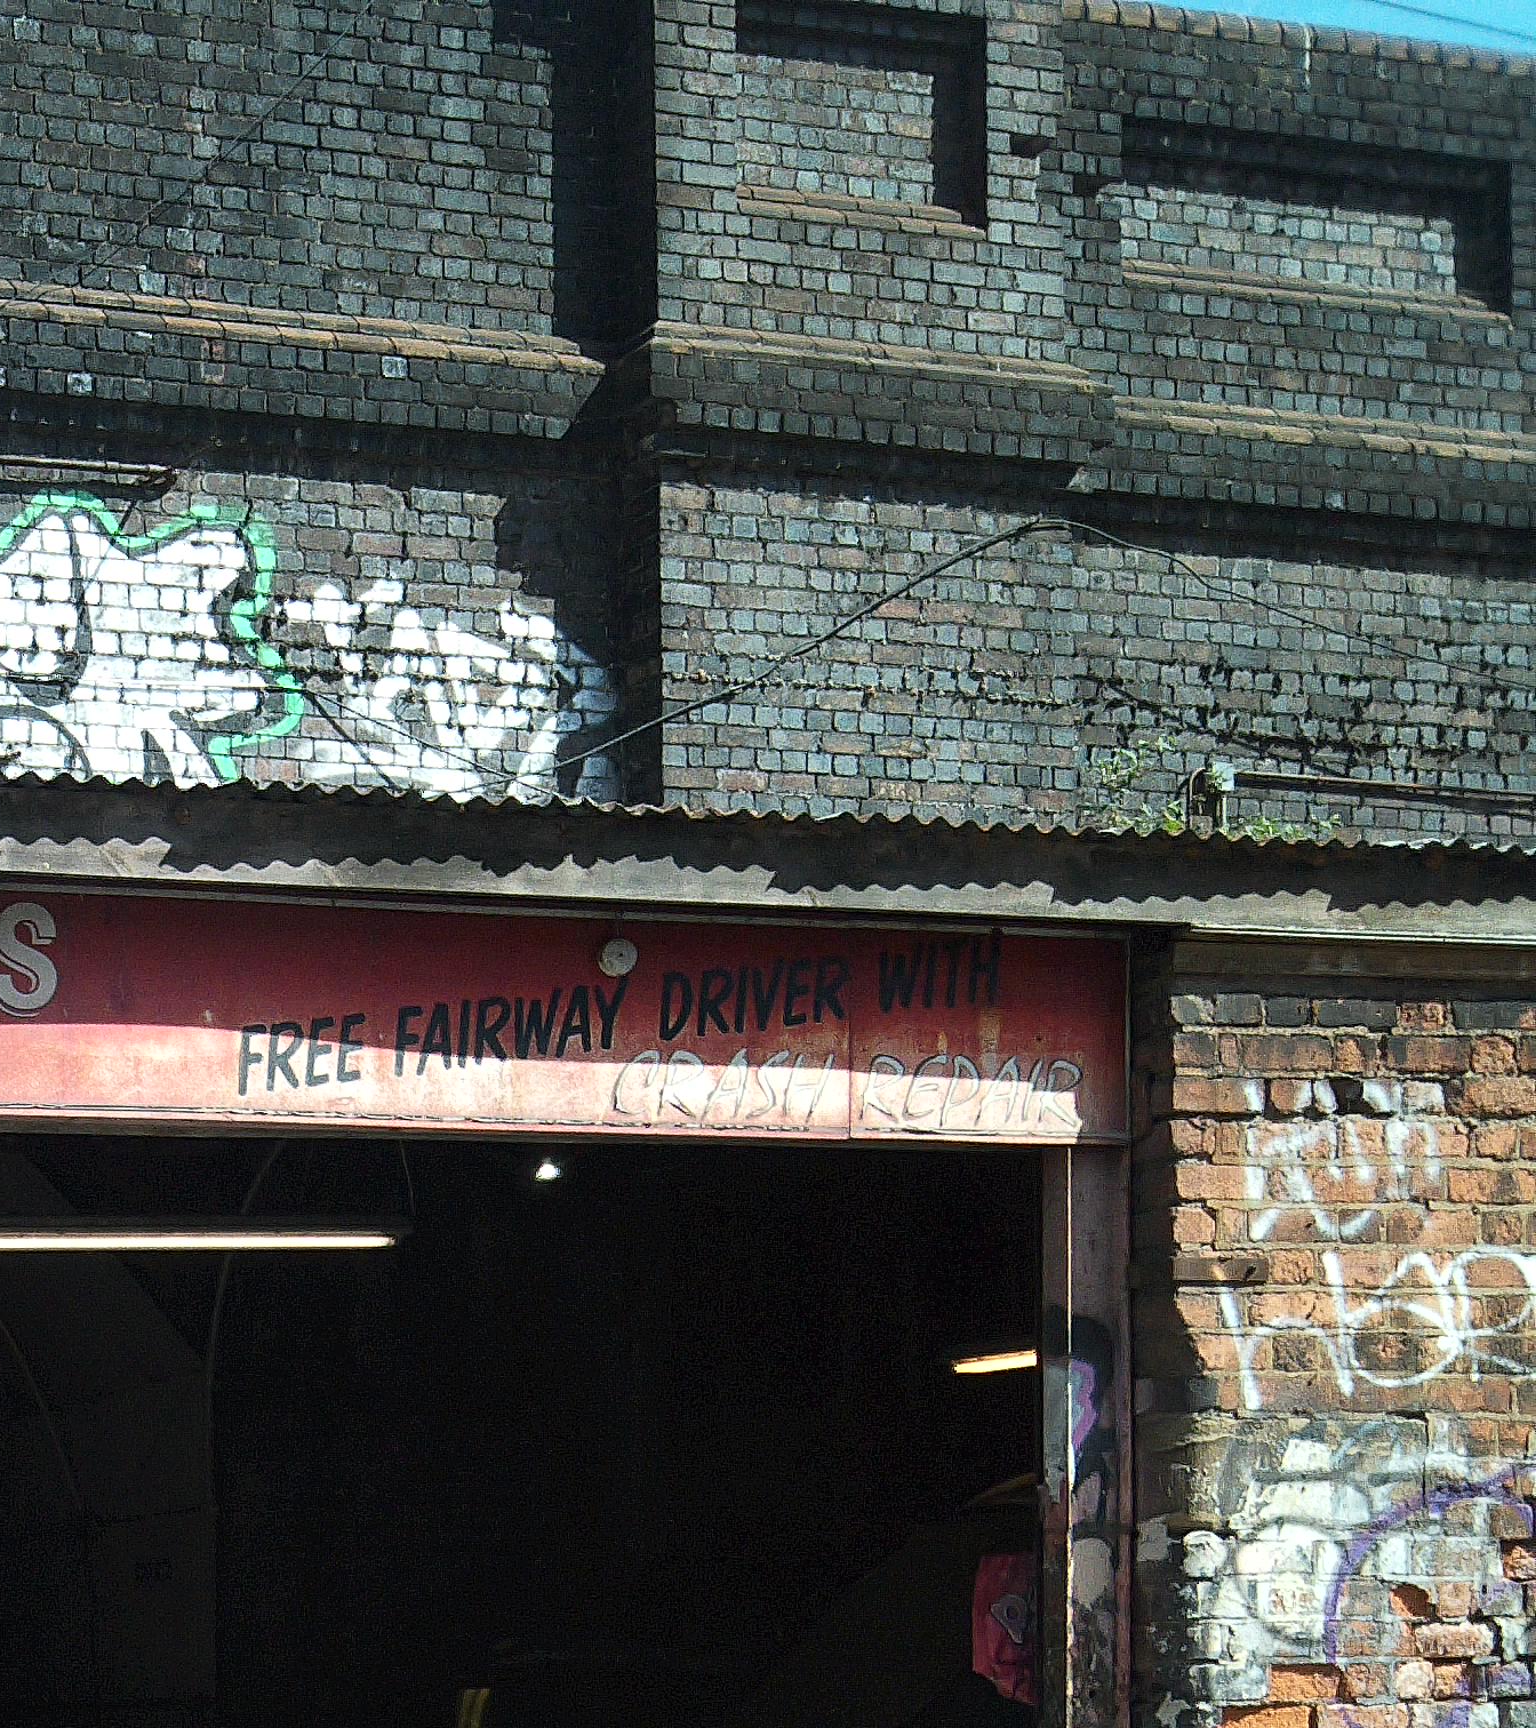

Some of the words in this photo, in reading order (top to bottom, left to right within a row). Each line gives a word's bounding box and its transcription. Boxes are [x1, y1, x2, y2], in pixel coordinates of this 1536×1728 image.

[237, 1012, 366, 1097] FREE
[393, 974, 629, 1077] FAIRWAY
[658, 954, 853, 1042] DRIVER
[878, 936, 1003, 1015] WITH
[612, 1047, 836, 1124] CRASH
[858, 1053, 1083, 1128] REPAIR
